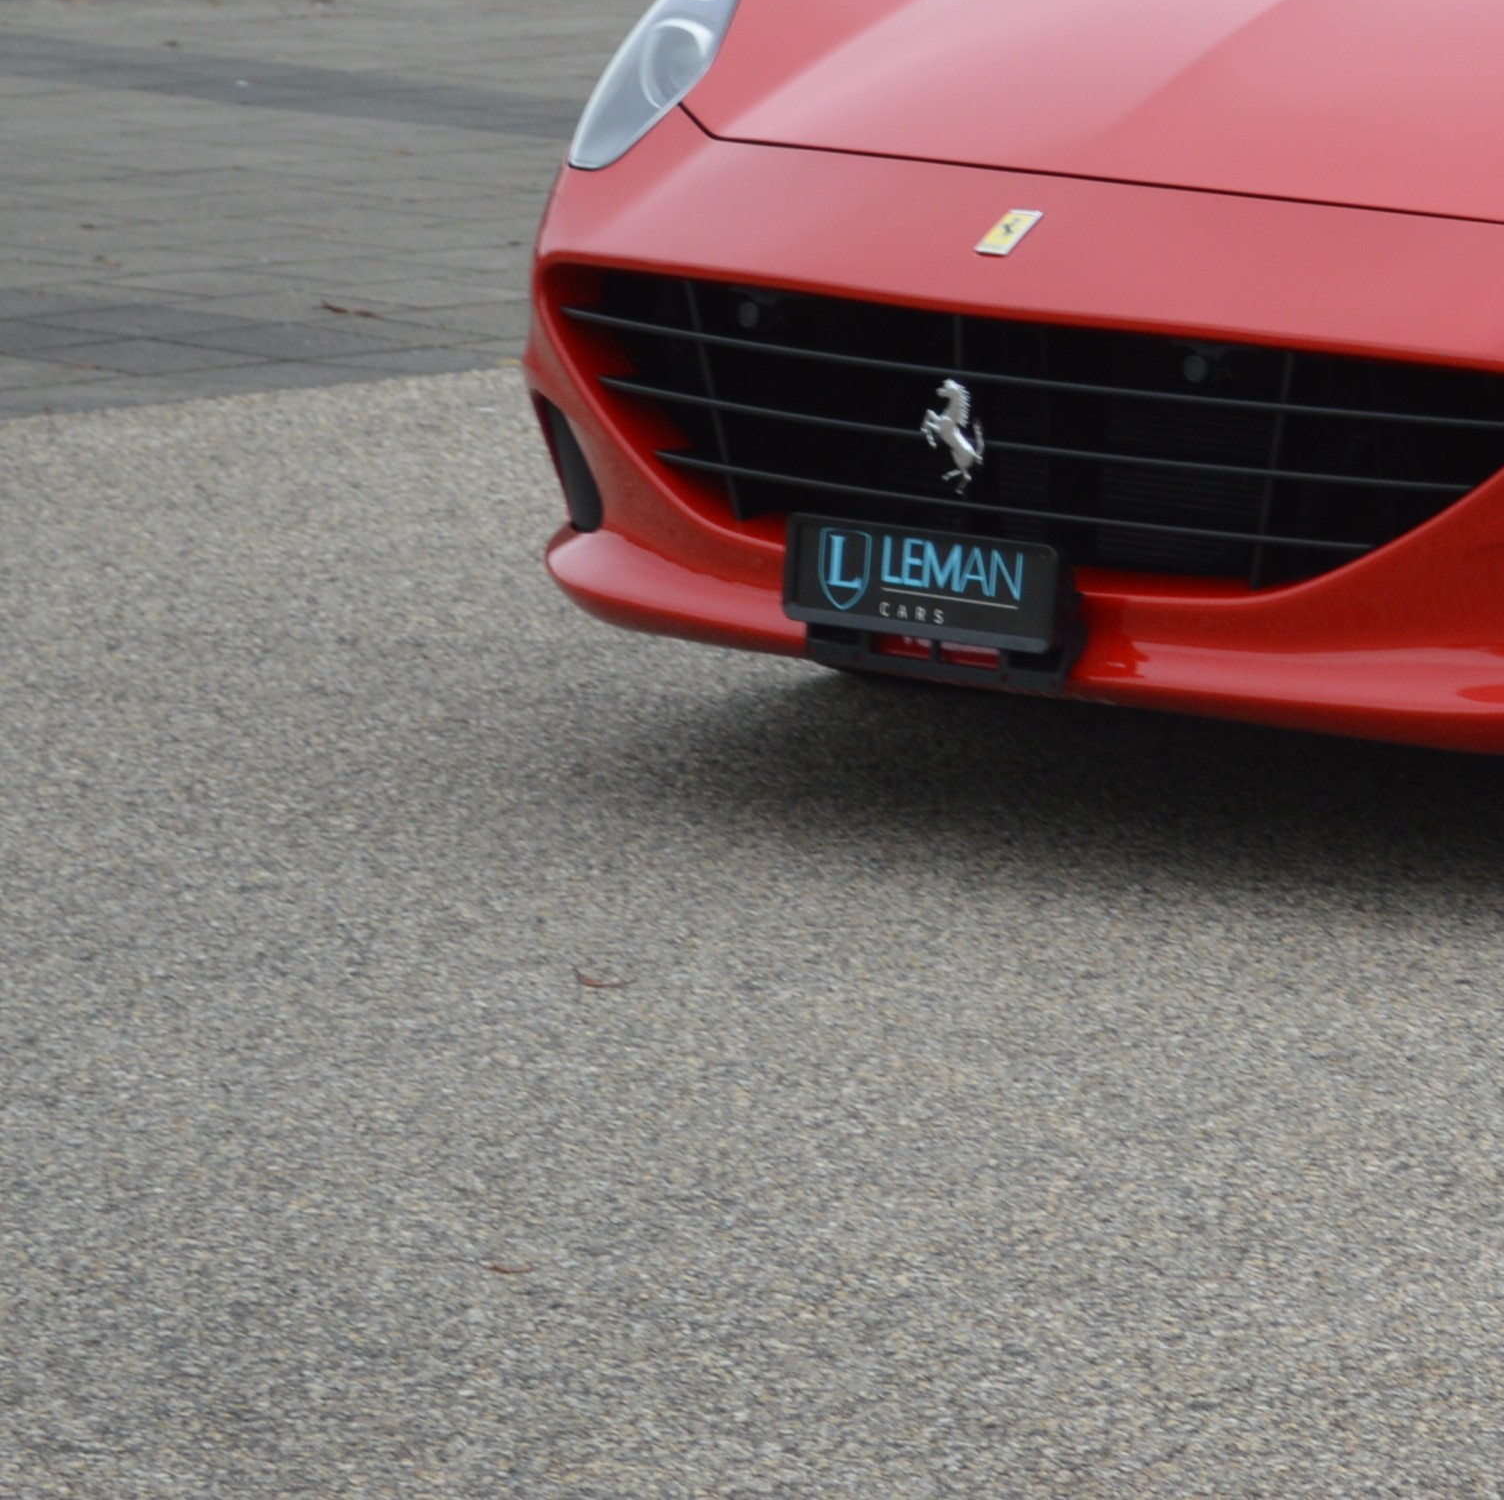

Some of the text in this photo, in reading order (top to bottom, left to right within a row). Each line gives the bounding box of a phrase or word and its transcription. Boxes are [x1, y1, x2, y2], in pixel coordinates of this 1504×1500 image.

[828, 535, 863, 590] L
[881, 535, 1024, 602] LEMAN
[879, 601, 944, 625] CARS
